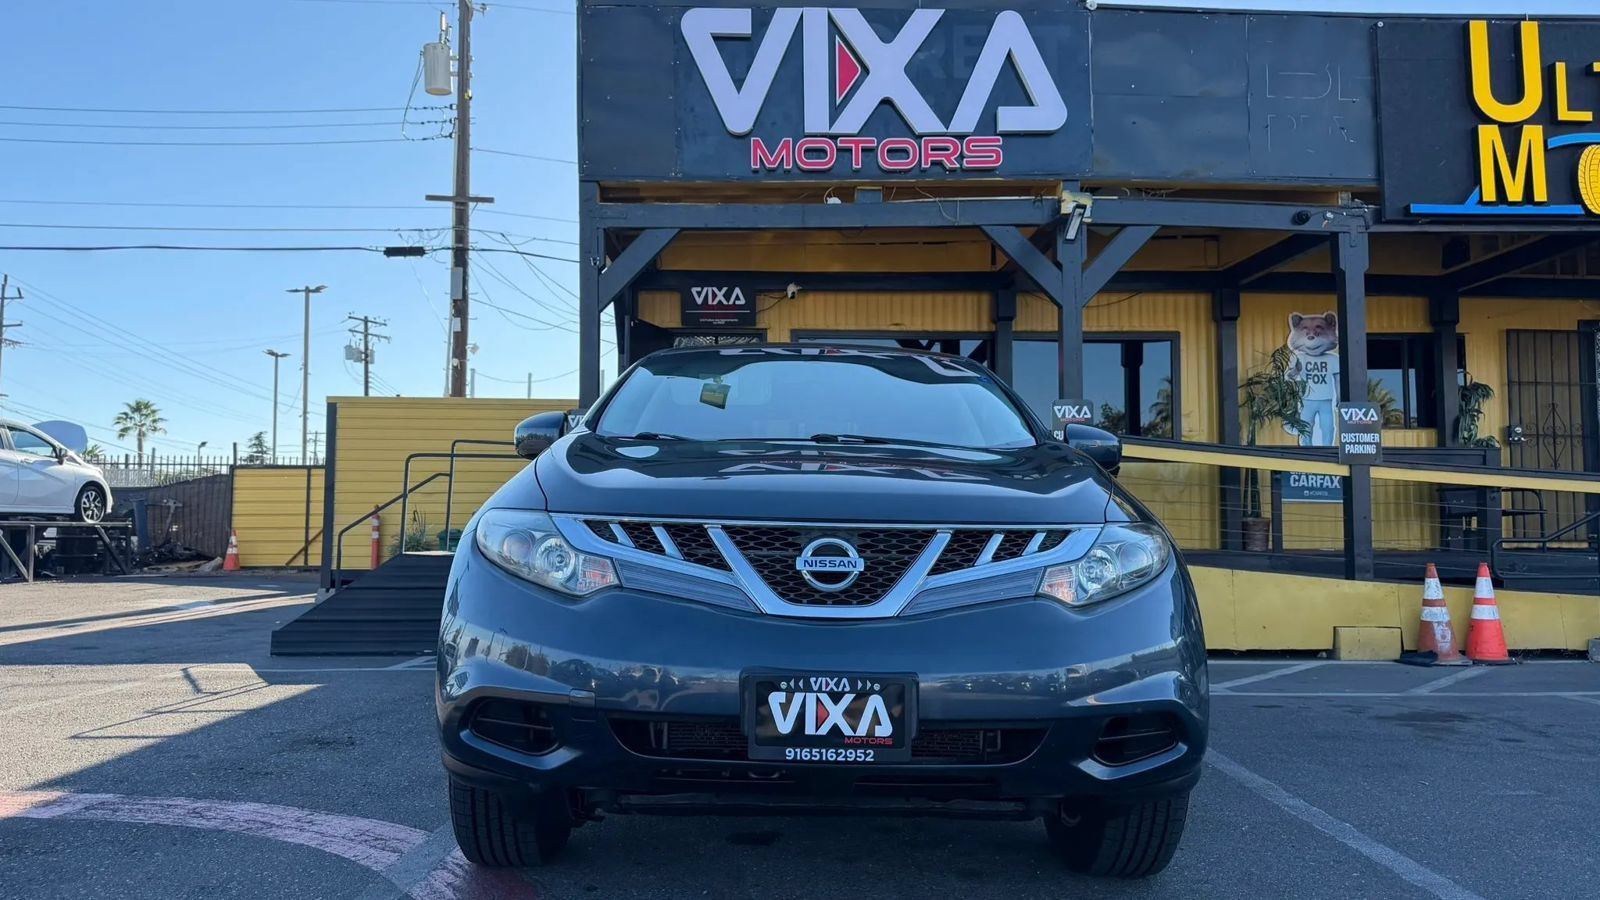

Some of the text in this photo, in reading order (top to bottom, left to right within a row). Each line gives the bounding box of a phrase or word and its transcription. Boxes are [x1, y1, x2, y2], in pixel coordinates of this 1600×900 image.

[681, 8, 1068, 136] VIXA
[1469, 20, 1600, 122] UL
[750, 137, 1003, 171] MOTORS
[691, 287, 746, 305] VIXA
[1305, 361, 1327, 372] CAR
[1306, 373, 1327, 385] FOX
[1053, 405, 1091, 418] VIXA
[1340, 408, 1378, 421] VIXA
[1341, 433, 1379, 443] CUSTOMER
[1345, 444, 1377, 455] PARKING
[1290, 474, 1341, 489] CARFAX
[803, 559, 857, 569] NISSAN
[809, 677, 850, 692] VIXA
[768, 691, 893, 737] VIXA
[844, 737, 893, 745] MOTORS
[785, 748, 875, 762] 9165162952
